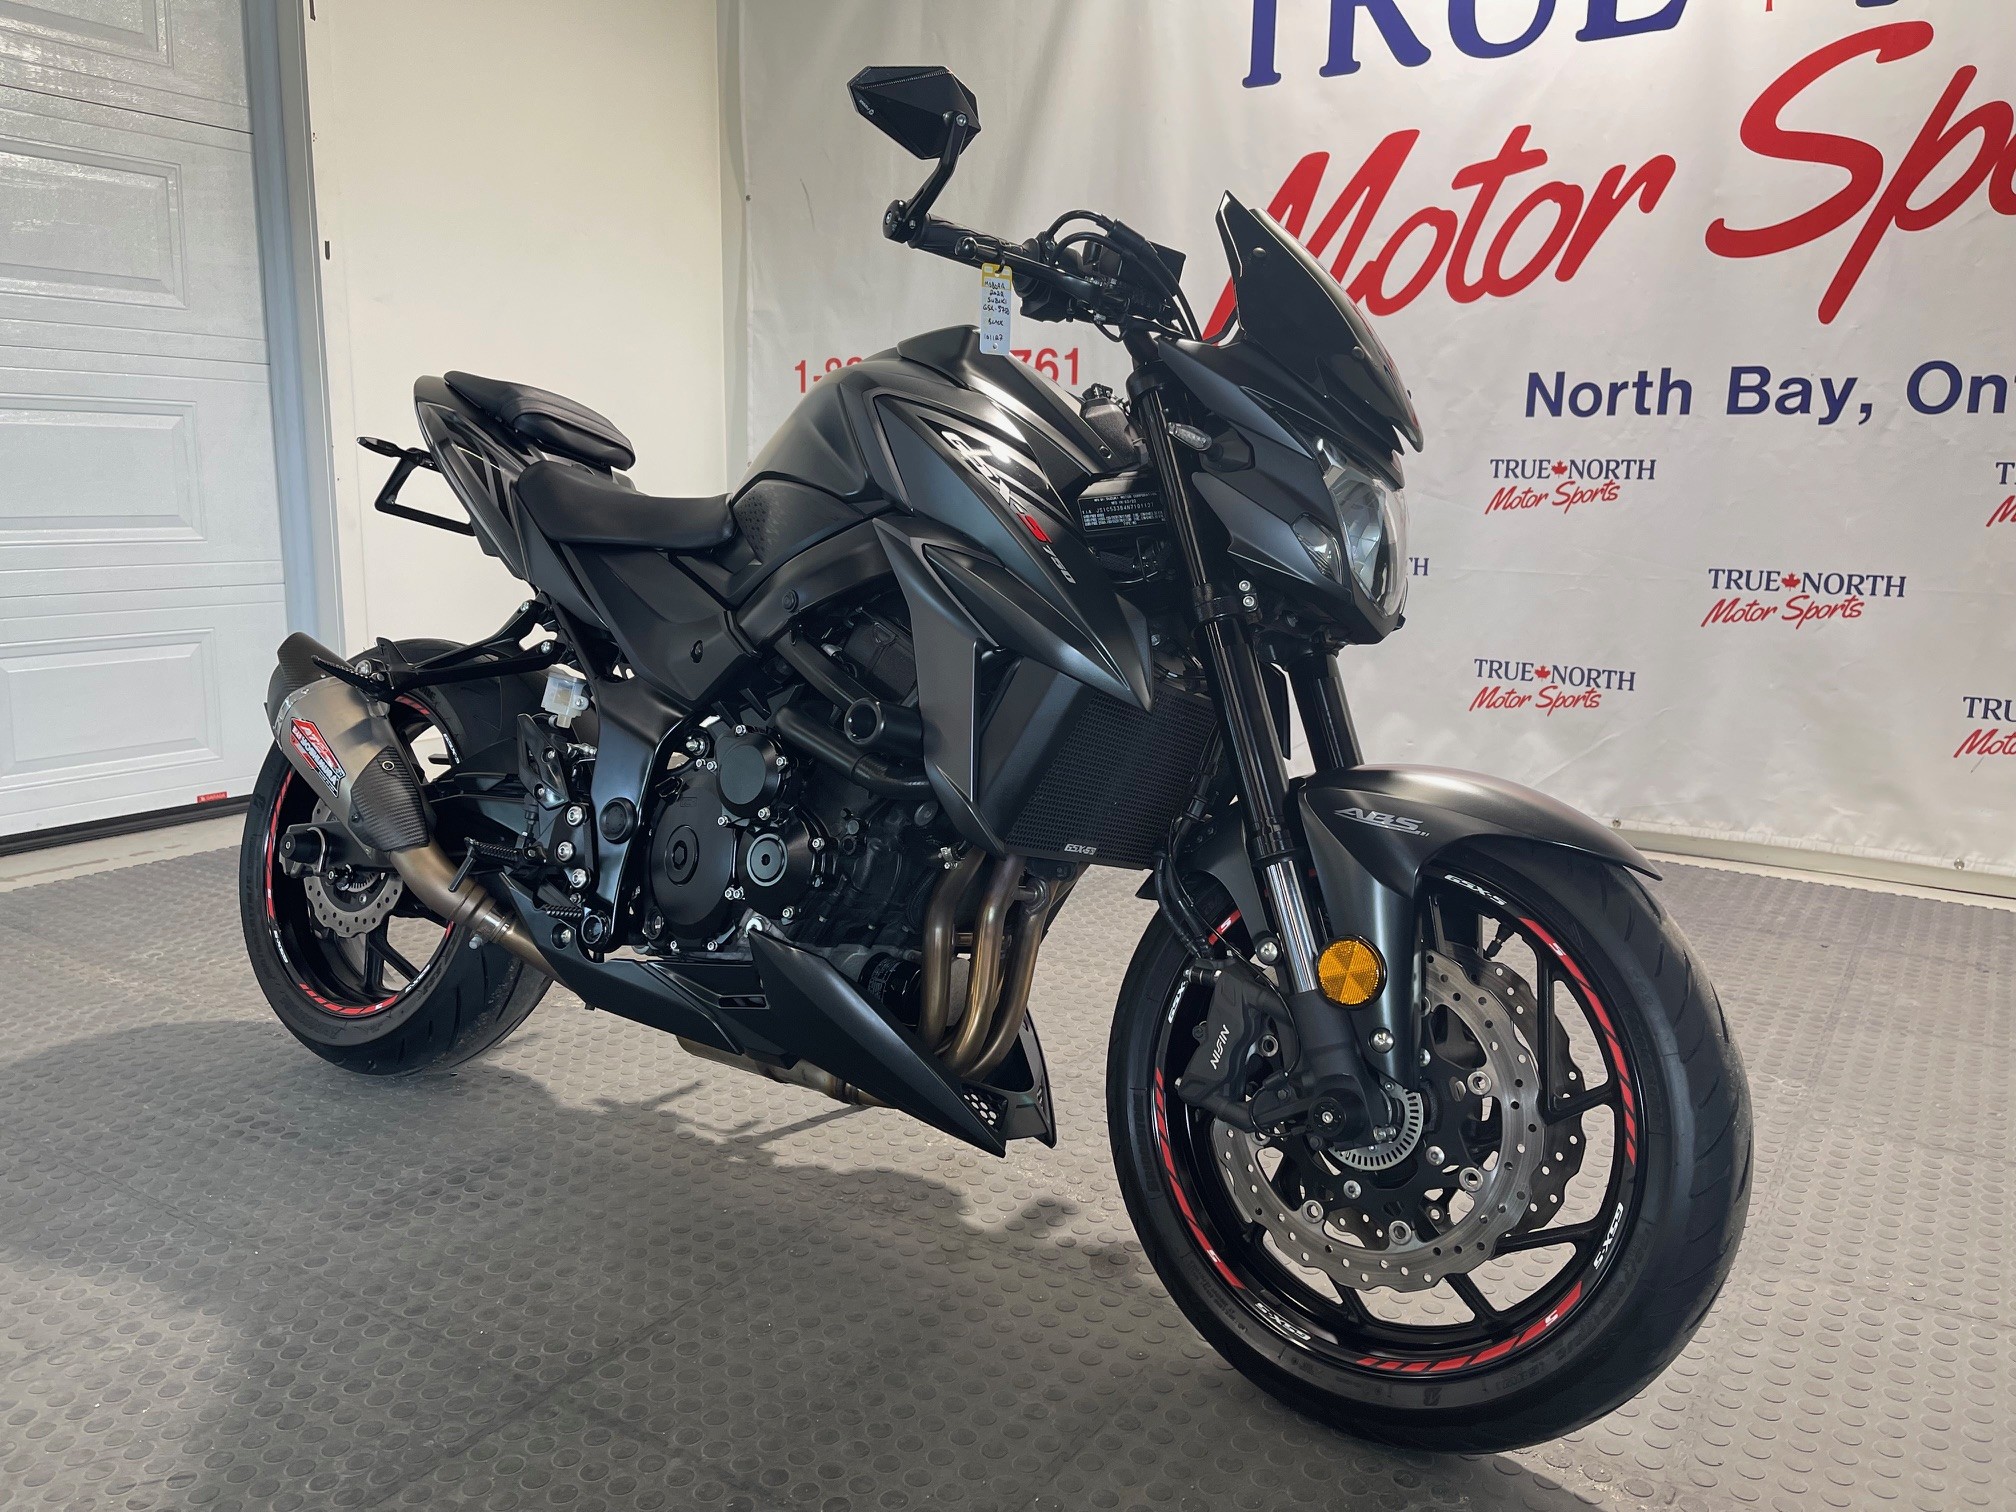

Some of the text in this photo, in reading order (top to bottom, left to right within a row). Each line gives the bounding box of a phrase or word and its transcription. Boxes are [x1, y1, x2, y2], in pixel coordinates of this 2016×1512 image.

[1201, 125, 1677, 345] Motor
[1525, 360, 2016, 425] North Bay, On
[1490, 458, 1657, 480] TRUE NORTH
[1484, 479, 1621, 515] Motor Sports
[1043, 544, 1076, 584] 750
[1708, 568, 1907, 598] TRUE NORTH
[1701, 594, 1865, 630] Motor Sports
[1474, 658, 1636, 692] TRUE NORTH
[1469, 685, 1602, 717] Motor Sports
[1336, 807, 1424, 832] ABS
[1444, 873, 1508, 907] GSX-S
[1593, 1201, 1625, 1270] GSX-S
[1254, 1302, 1312, 1341] GSX-S
